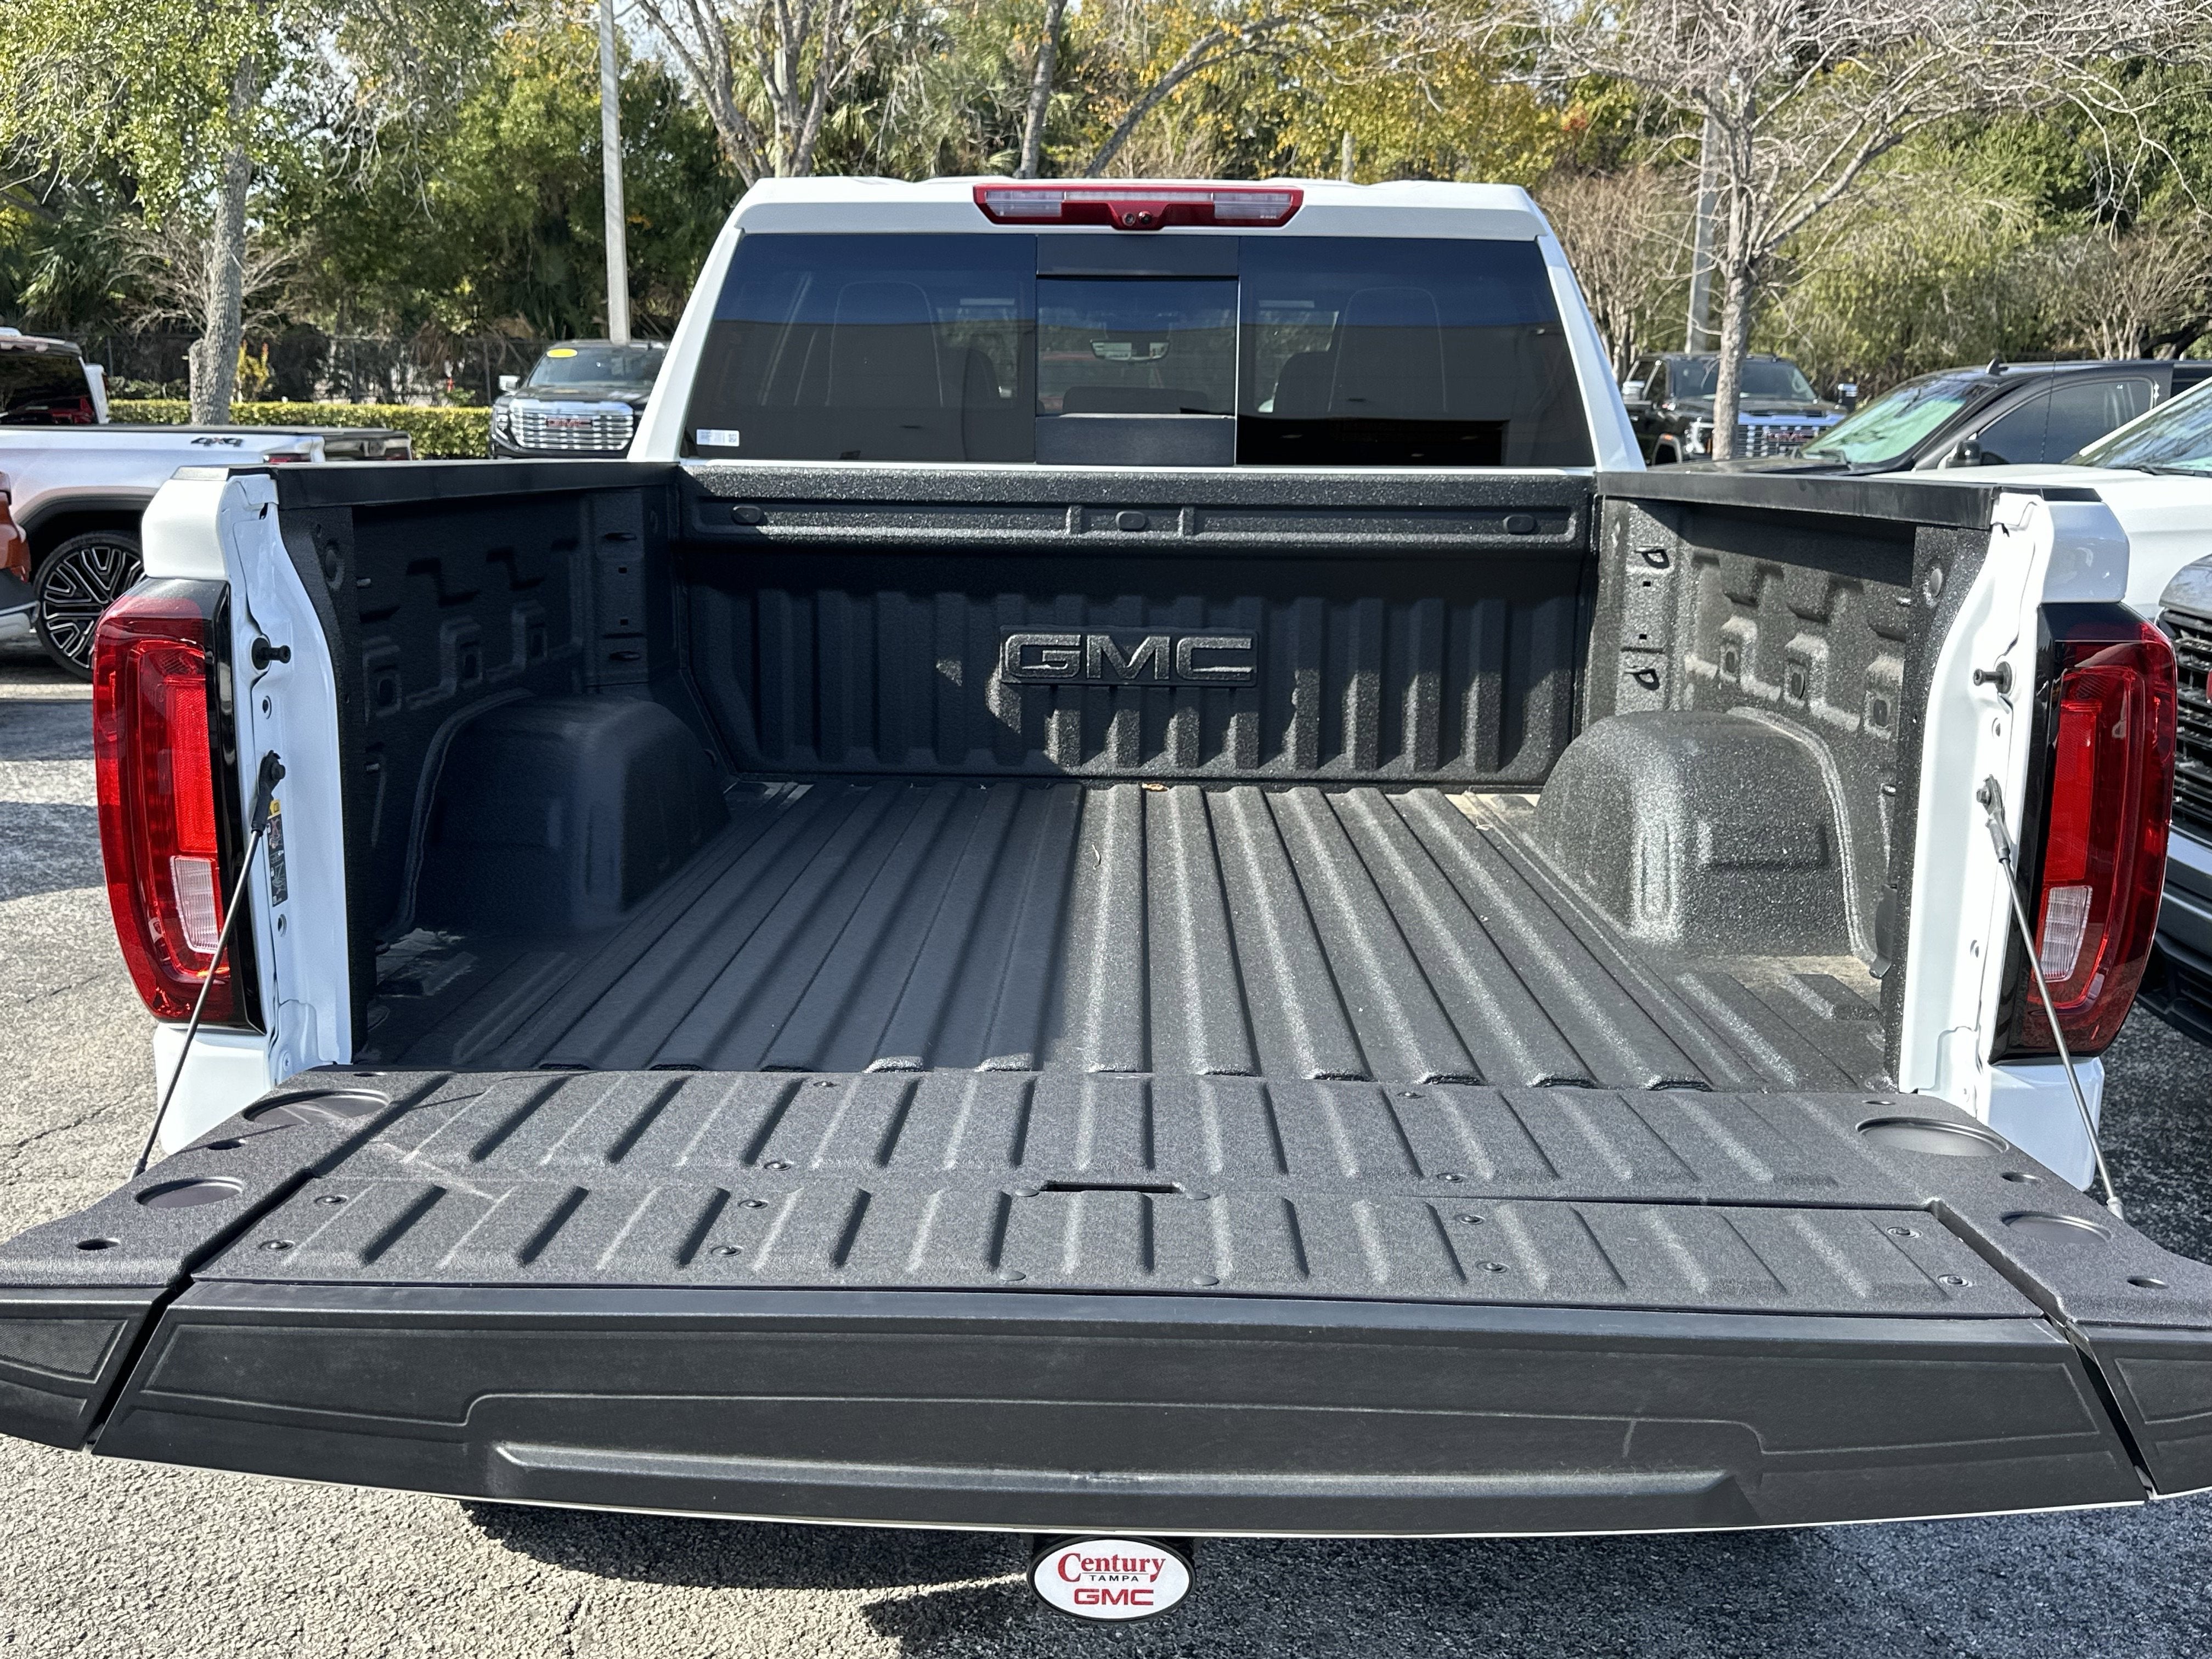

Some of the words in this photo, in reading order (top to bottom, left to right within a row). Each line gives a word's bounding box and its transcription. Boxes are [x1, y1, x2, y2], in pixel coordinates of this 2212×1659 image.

[1005, 634, 1253, 681] GMC
[1058, 1553, 1166, 1583] Century
[1074, 1588, 1154, 1606] GMC
